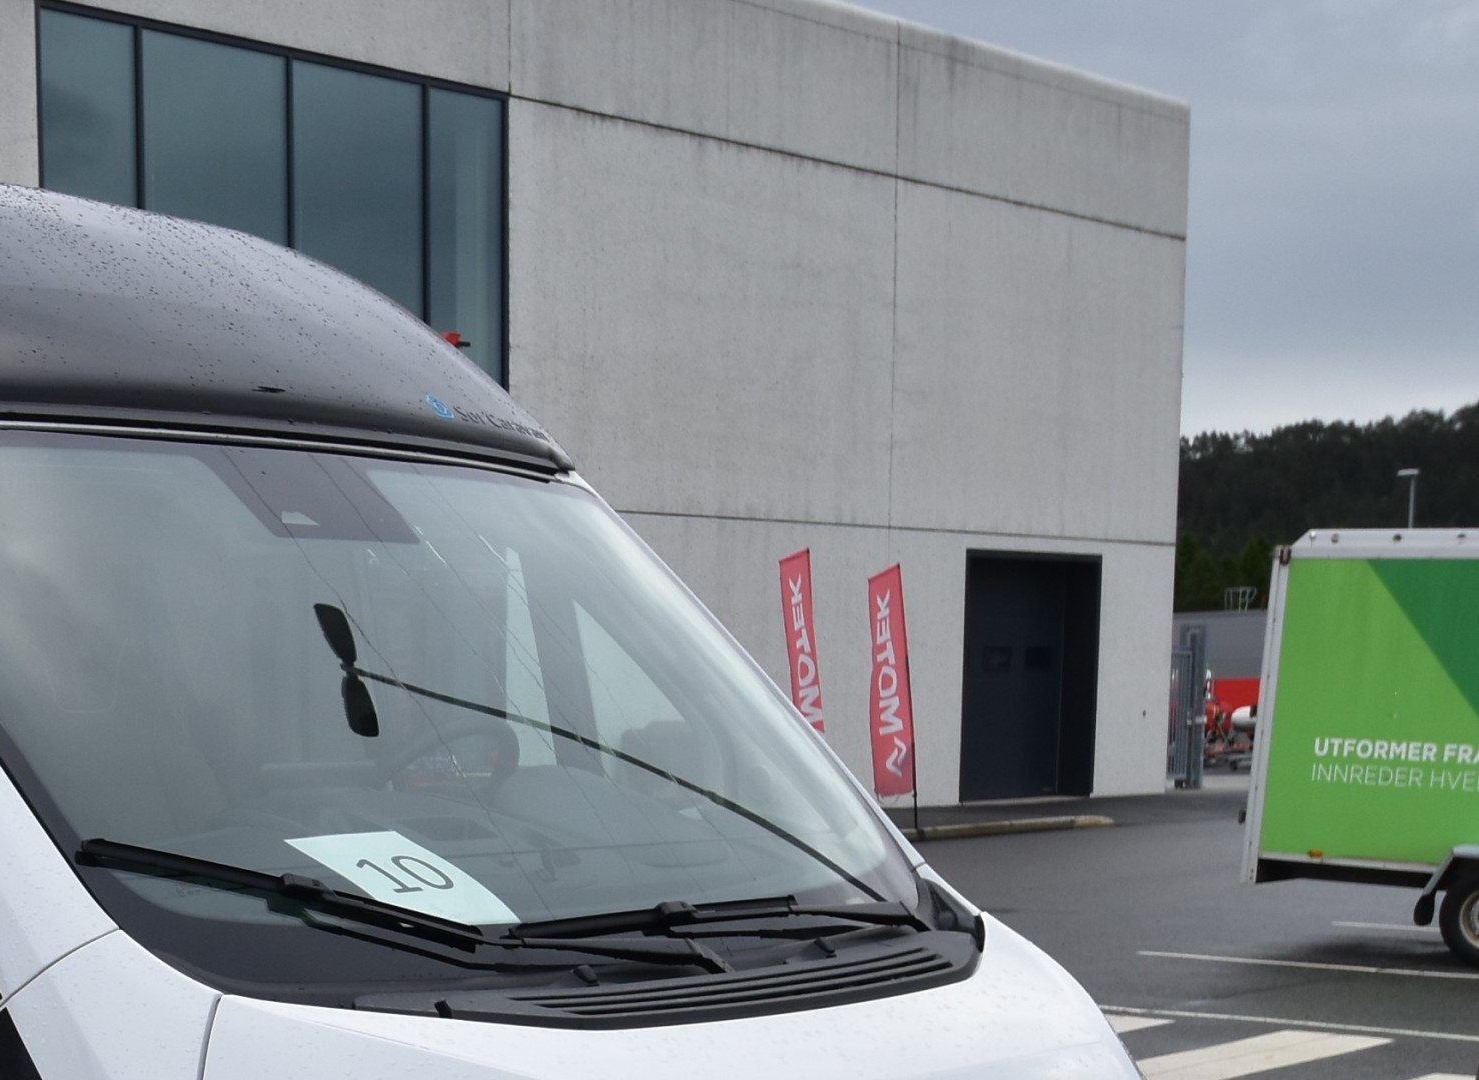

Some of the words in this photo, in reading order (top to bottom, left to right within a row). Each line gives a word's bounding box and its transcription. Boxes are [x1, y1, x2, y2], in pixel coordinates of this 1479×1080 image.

[876, 588, 904, 736] MOTEK
[1314, 737, 1437, 763] UTFORMER
[1311, 763, 1424, 789] INNREDER
[1429, 769, 1479, 793] HVE
[355, 855, 455, 894] 10
